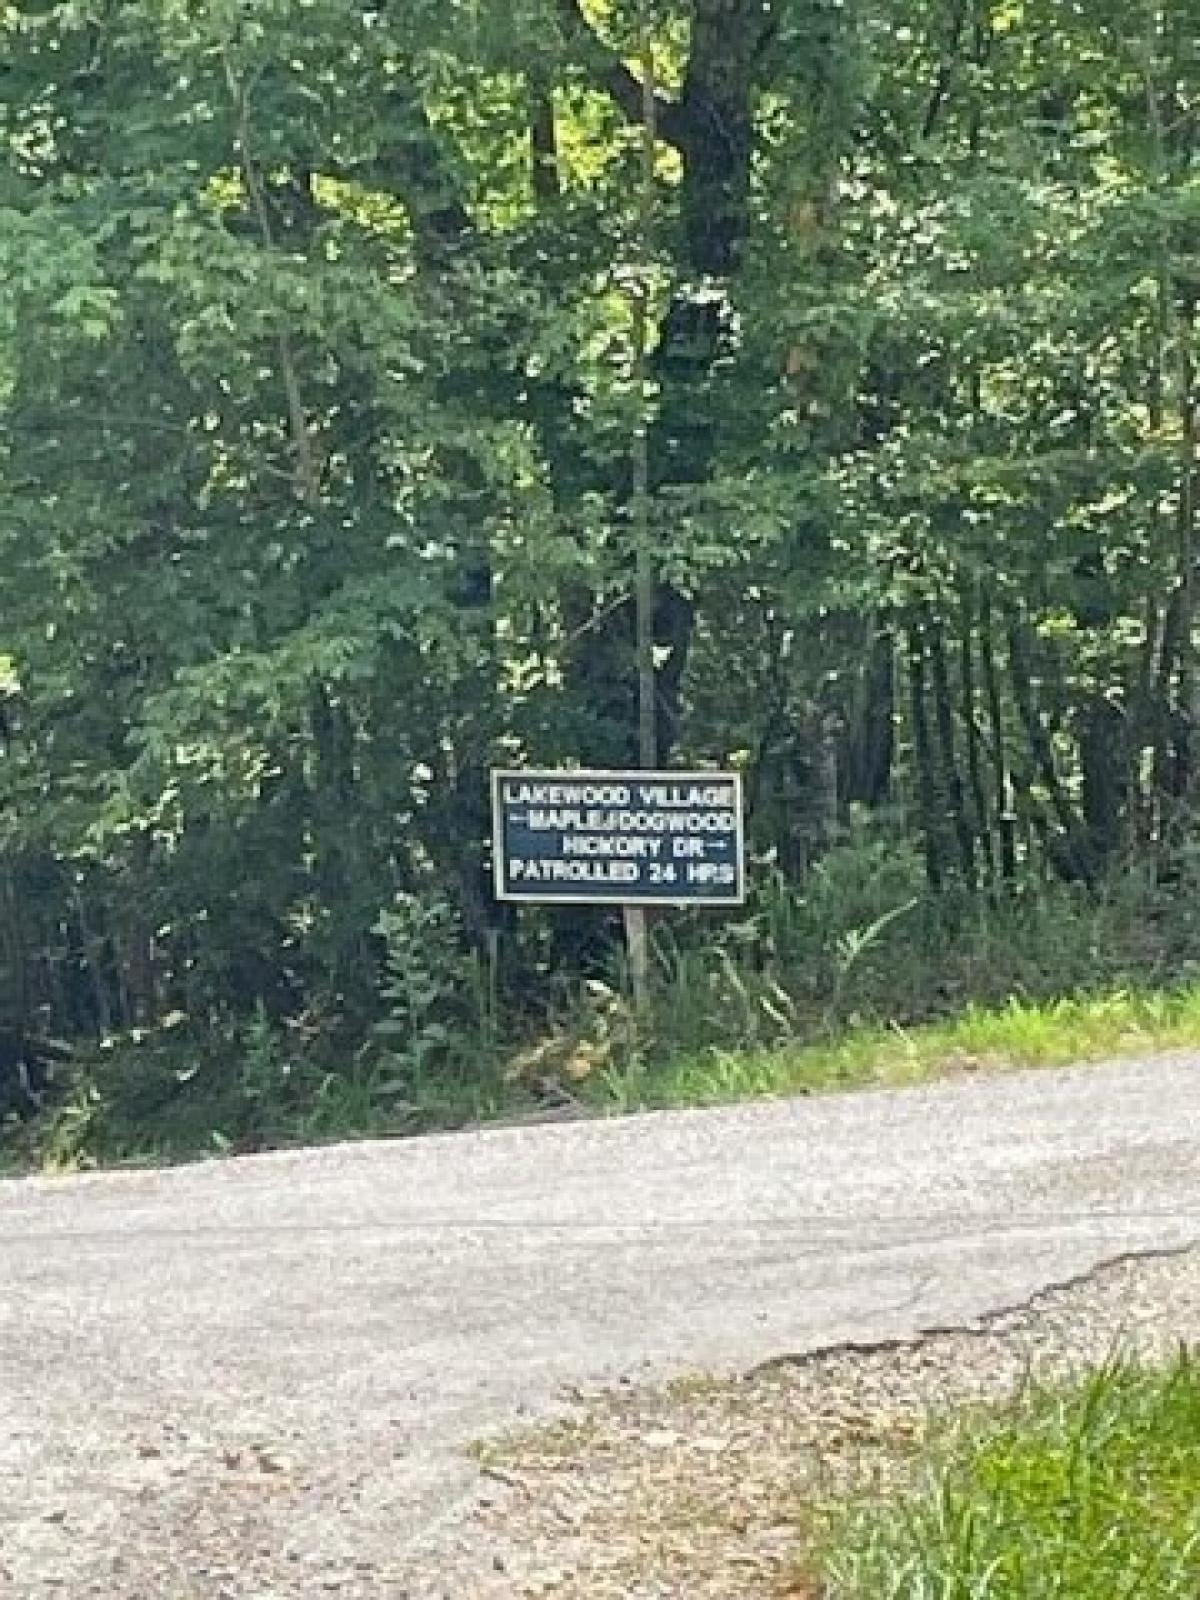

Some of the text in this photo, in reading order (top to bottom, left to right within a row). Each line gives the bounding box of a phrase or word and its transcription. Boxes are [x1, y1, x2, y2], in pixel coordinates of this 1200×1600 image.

[503, 783, 735, 808] LAKEWOOD VILLAGE
[563, 836, 705, 857] HICKORY DR
[509, 859, 735, 884] PATROLLED 24 HRS
